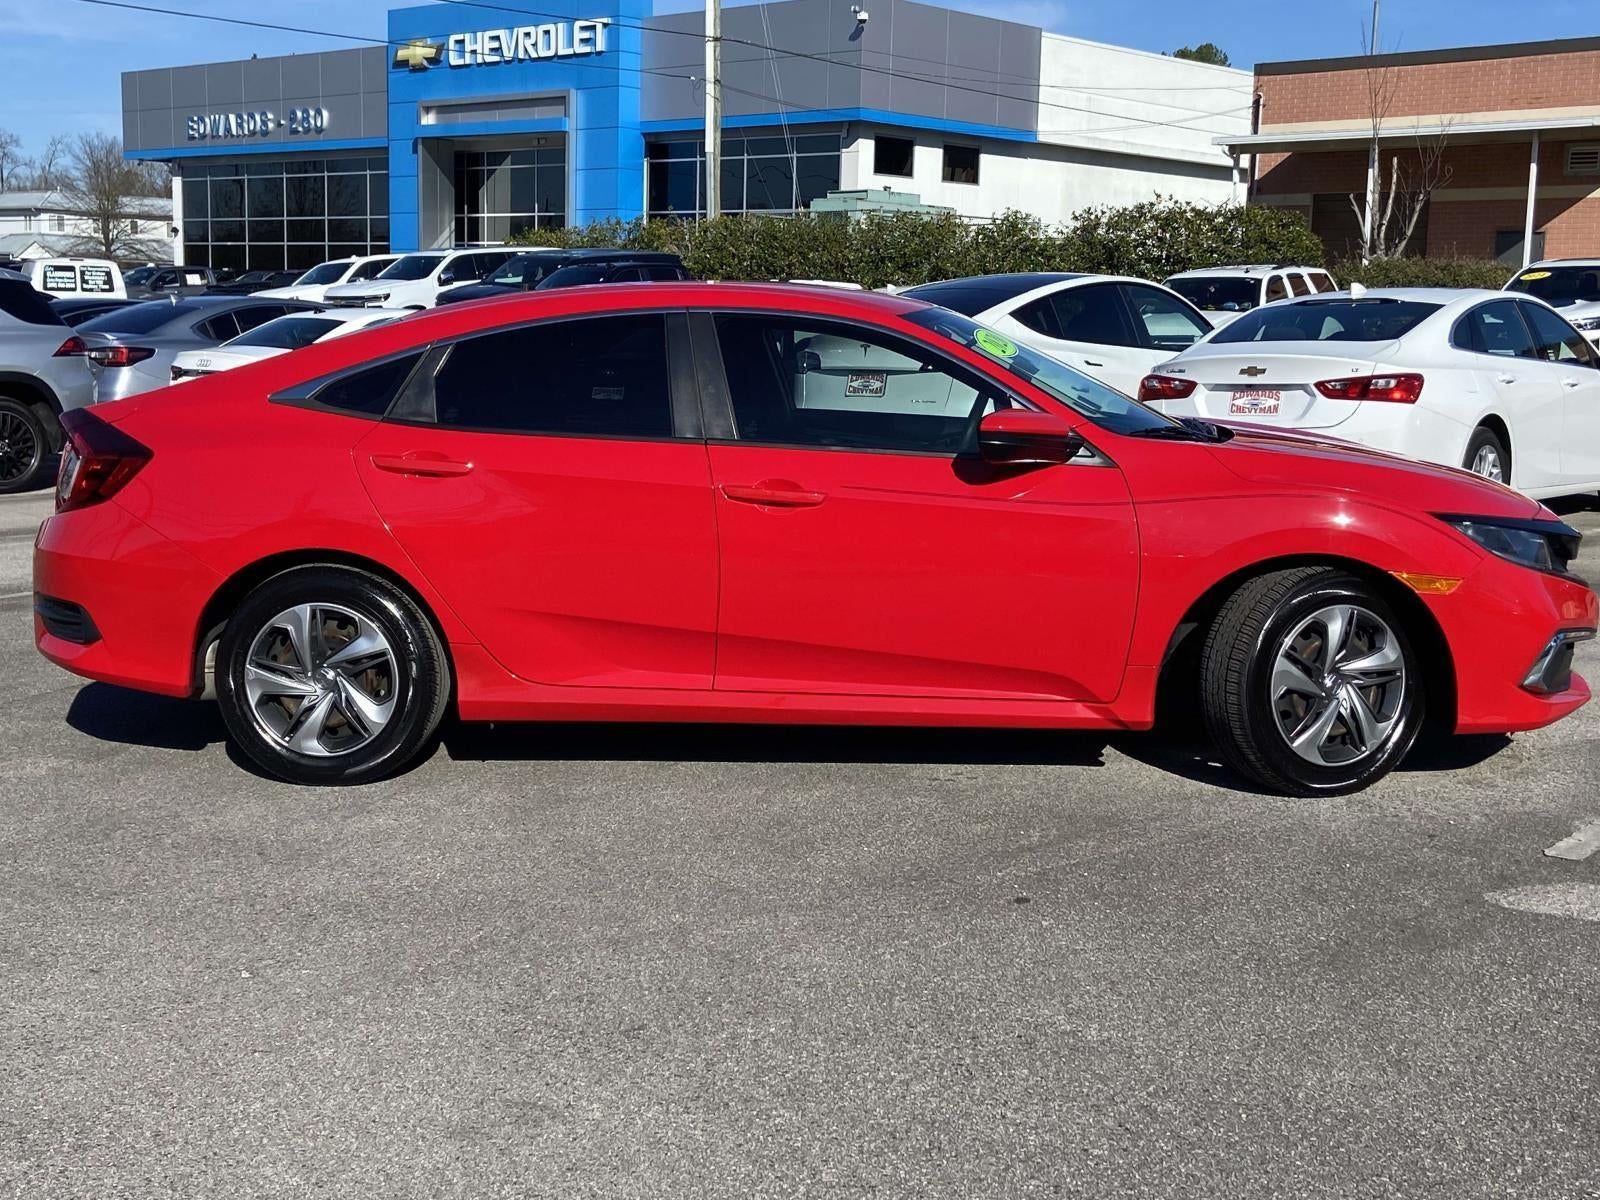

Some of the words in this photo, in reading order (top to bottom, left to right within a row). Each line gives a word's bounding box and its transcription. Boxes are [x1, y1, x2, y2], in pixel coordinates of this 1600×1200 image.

[449, 18, 611, 66] CHEVROLET
[187, 111, 274, 141] EDWARDS
[289, 107, 329, 135] 280
[850, 373, 884, 384] EDWARDS
[847, 384, 883, 395] CHEVYMAN
[1232, 390, 1280, 401] EDWARDS
[1230, 402, 1279, 414] CHEVYMAN
